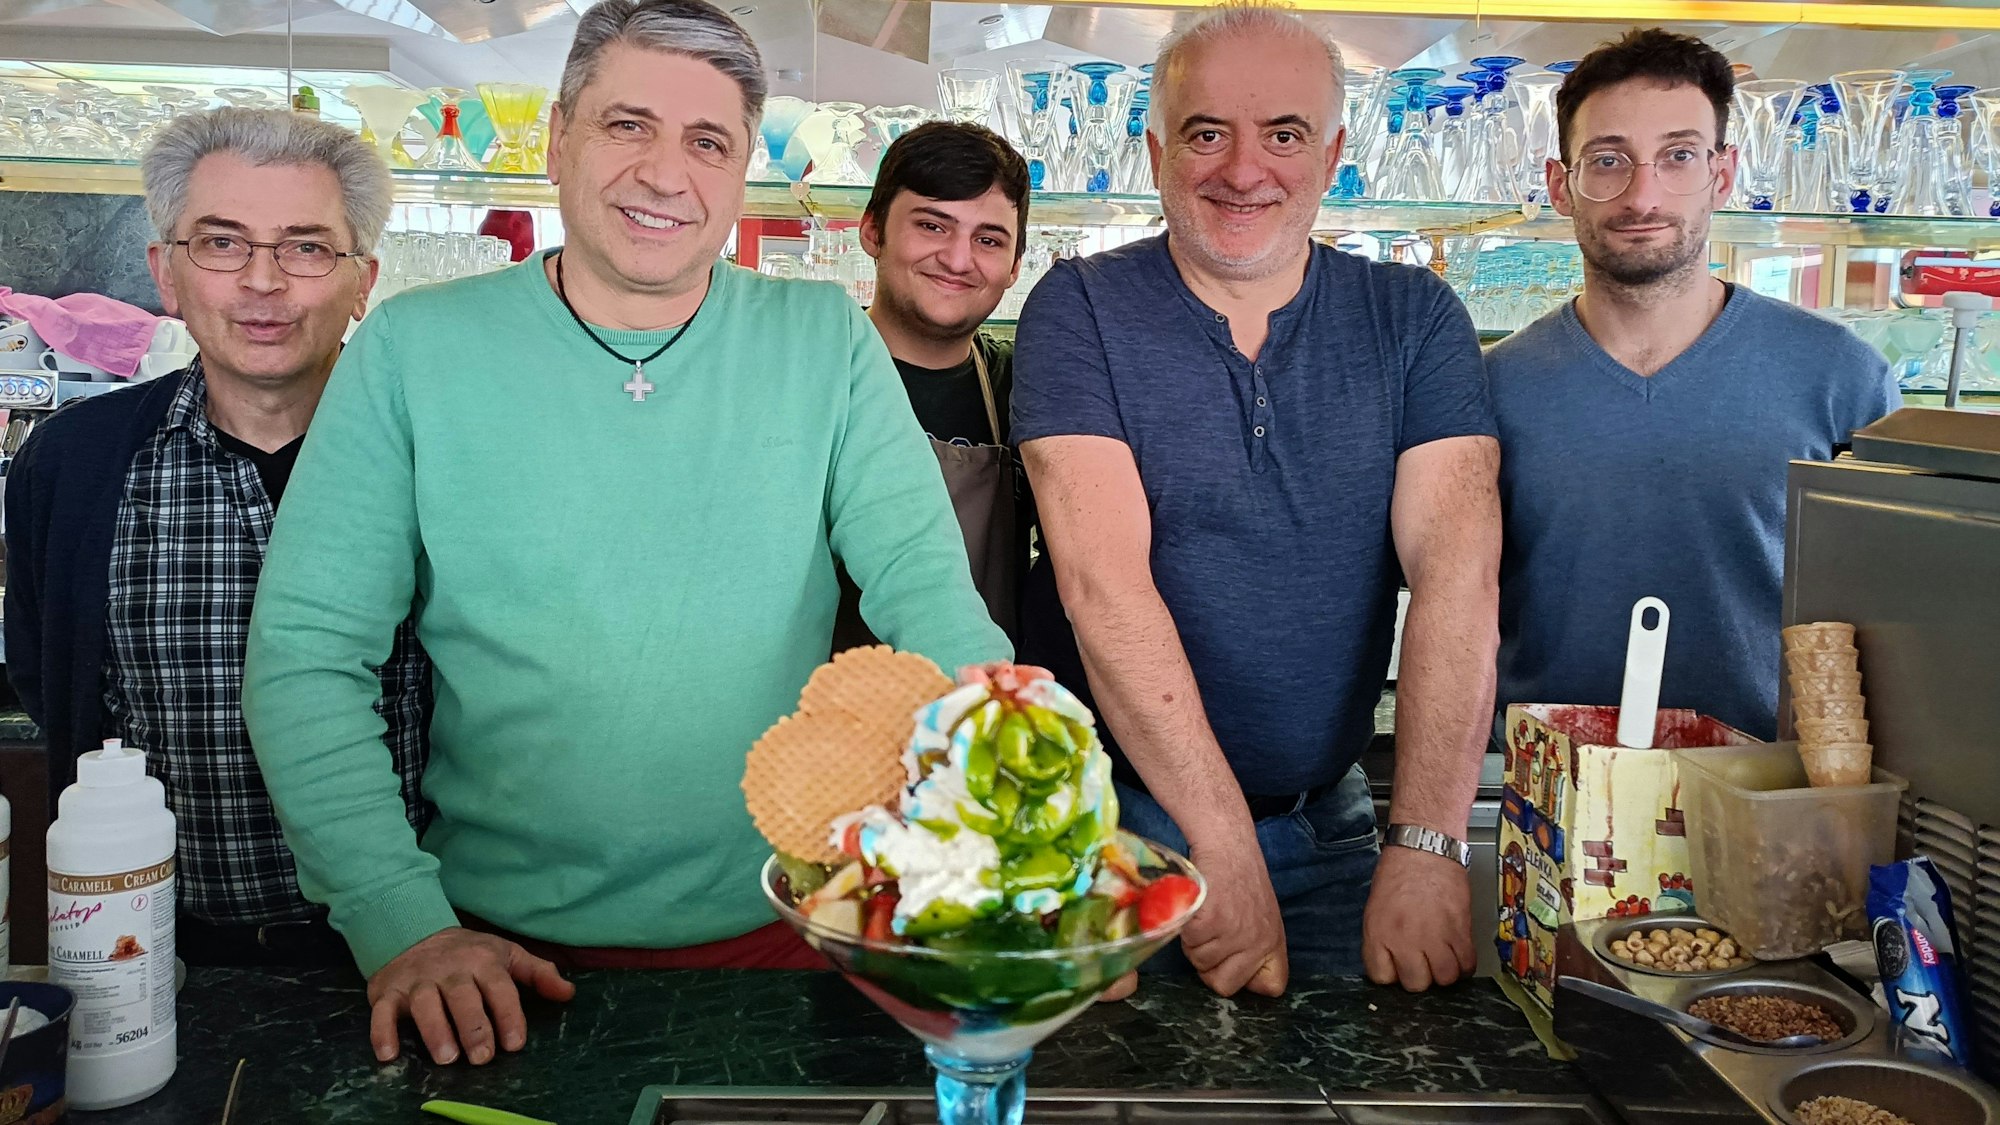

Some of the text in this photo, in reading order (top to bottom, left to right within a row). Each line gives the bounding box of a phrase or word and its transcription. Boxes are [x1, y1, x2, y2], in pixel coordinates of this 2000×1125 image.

[1526, 847, 1553, 878] ELENKA
[62, 877, 114, 892] CARAMELL
[124, 871, 159, 888] CREAM
[57, 946, 104, 960] CARAMELL
[116, 1026, 148, 1045] 56204
